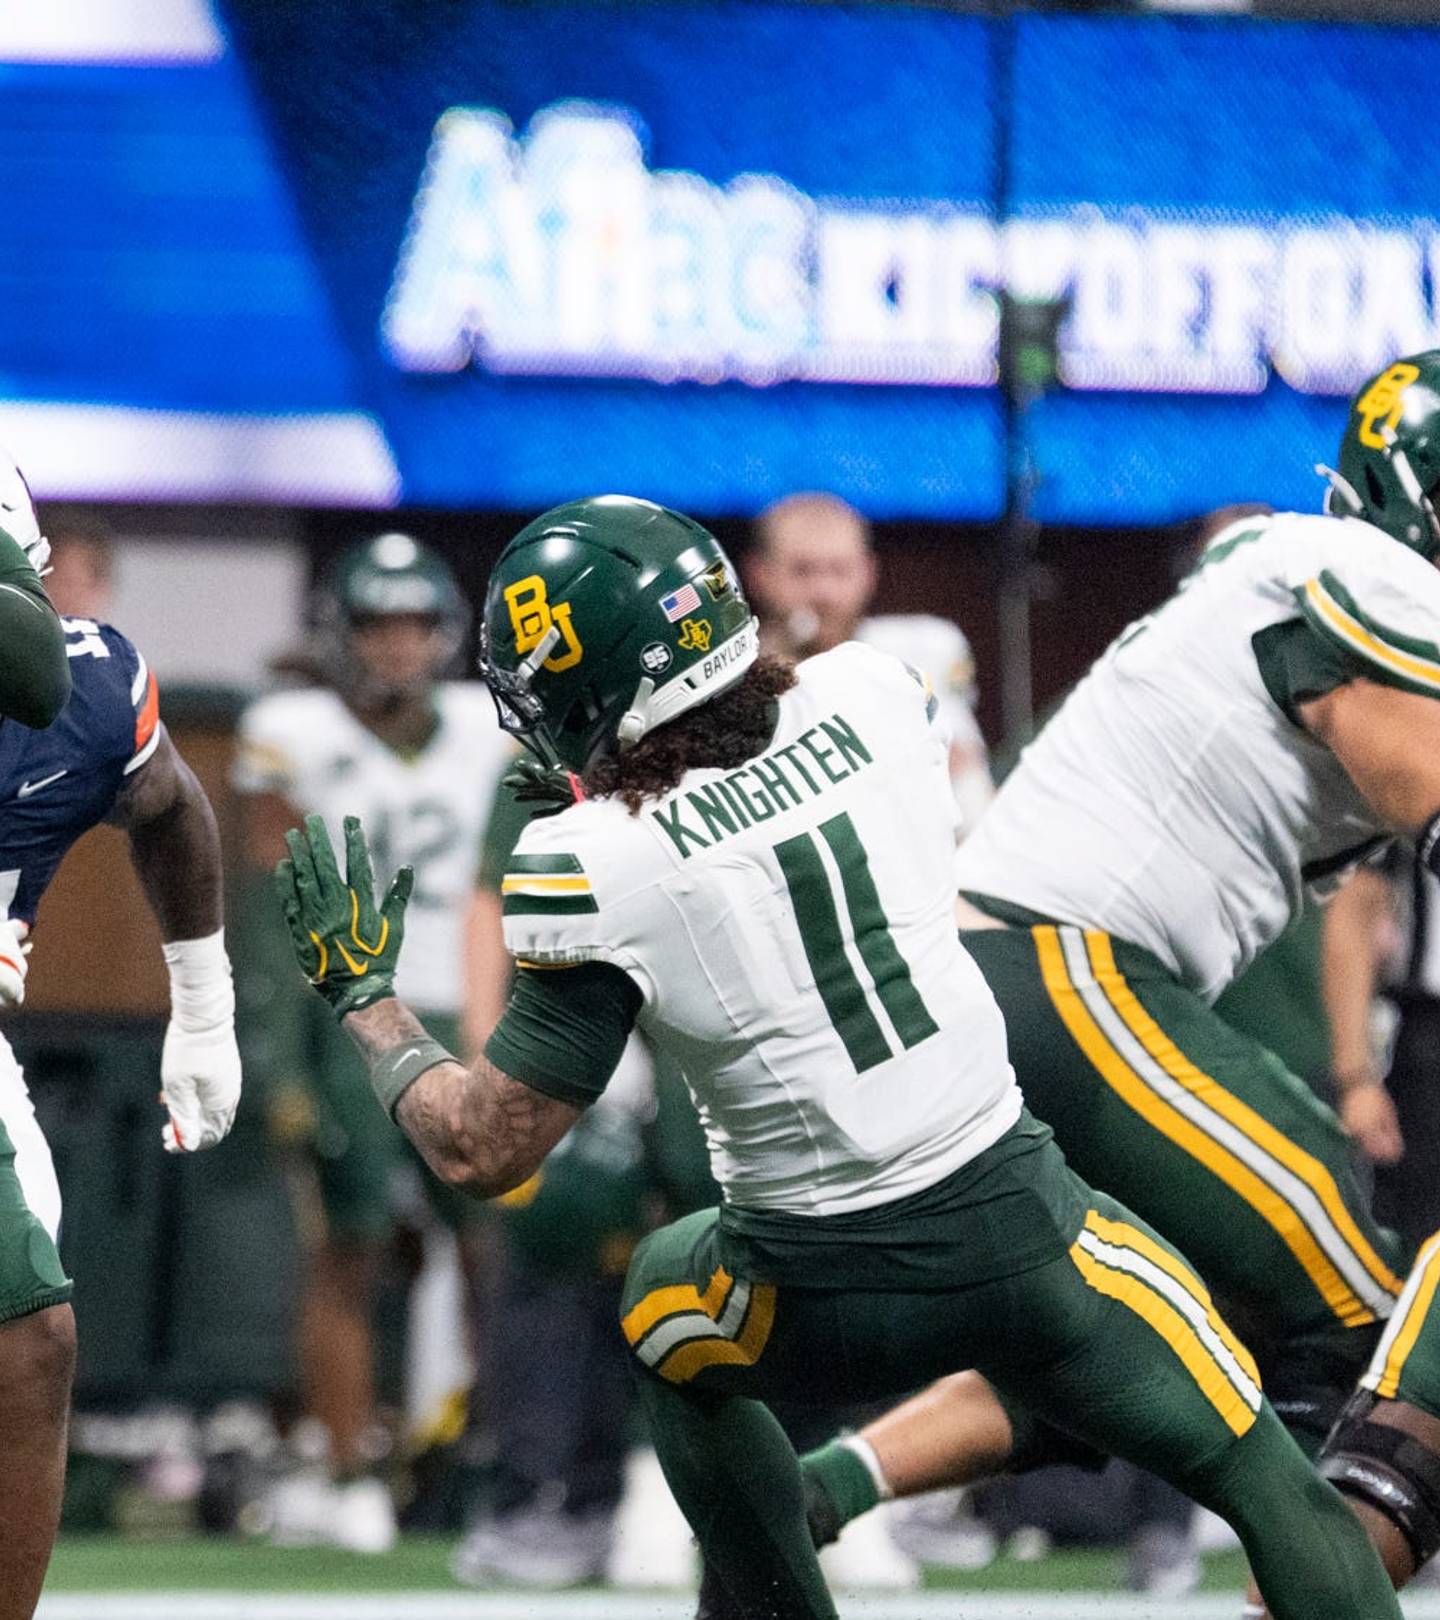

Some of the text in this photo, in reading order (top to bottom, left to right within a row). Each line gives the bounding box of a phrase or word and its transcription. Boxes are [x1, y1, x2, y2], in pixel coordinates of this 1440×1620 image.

[390, 108, 808, 382] Aflac
[703, 635, 748, 680] BAYLOR
[652, 713, 874, 859] KNIGHTEN
[772, 811, 940, 1074] 11
